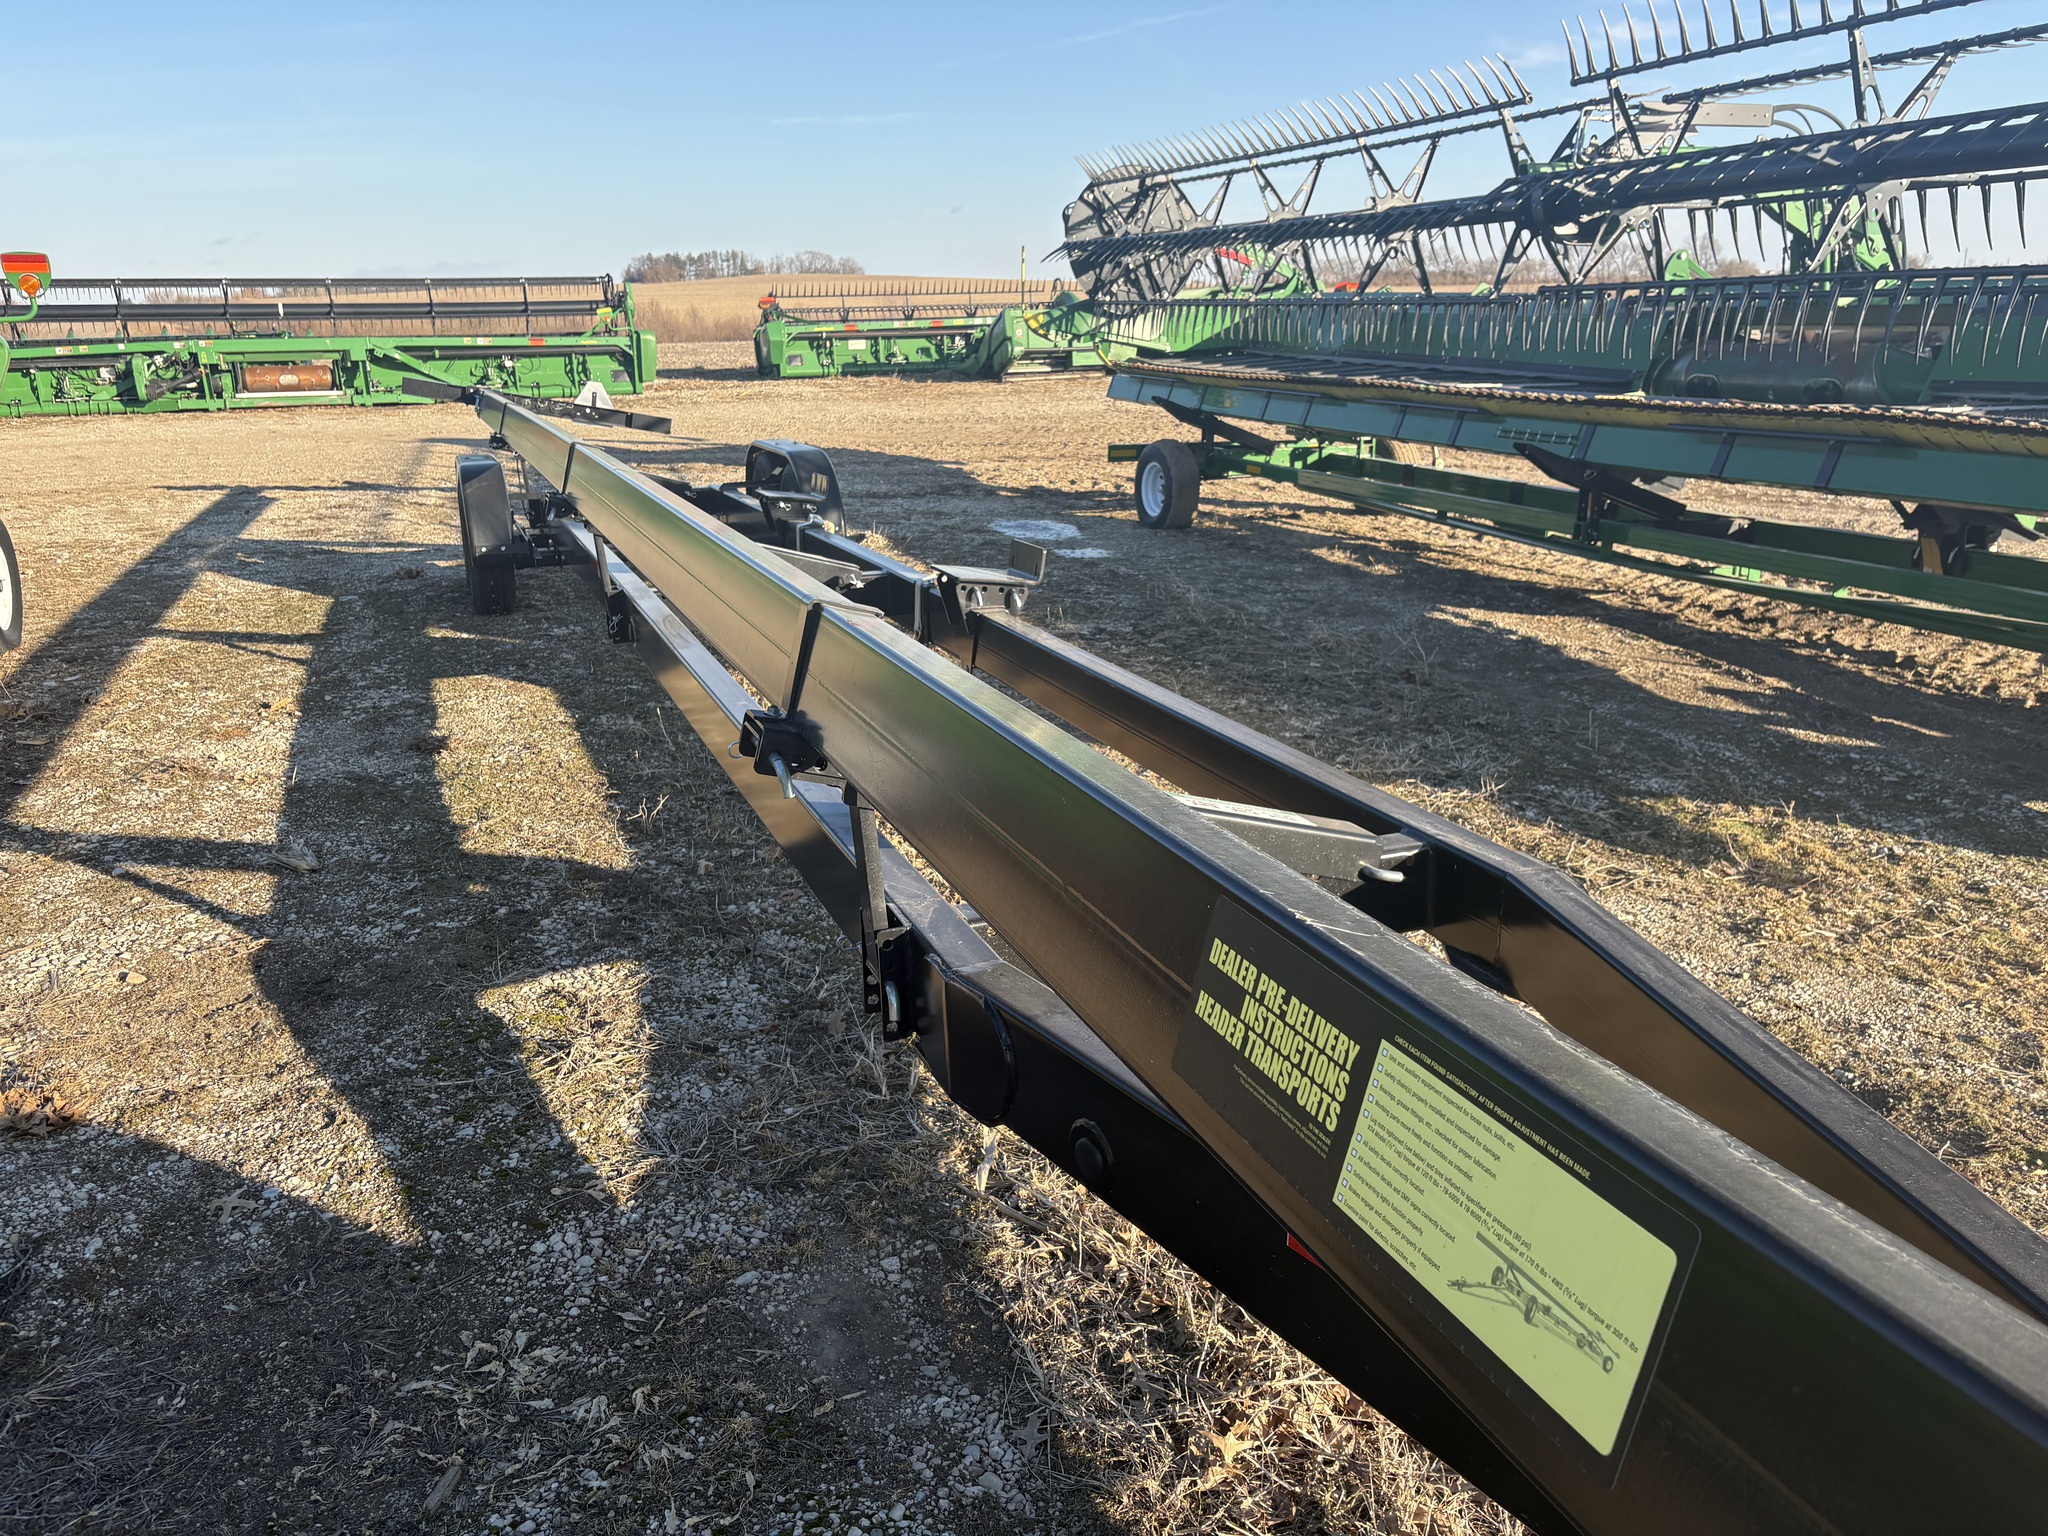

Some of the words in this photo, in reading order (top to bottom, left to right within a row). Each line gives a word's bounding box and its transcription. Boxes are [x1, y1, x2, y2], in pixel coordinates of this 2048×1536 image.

[1194, 989, 1245, 1051] HEADER
[1243, 1029, 1341, 1132] TRANSPORTS
[1208, 937, 1258, 994] DEALER
[1254, 972, 1361, 1071] PRE-DELIVERY
[1239, 993, 1350, 1102] INSTRUCTIONS
[1394, 1034, 1409, 1049] CHECK
[1407, 1044, 1421, 1057] EACH
[1419, 1052, 1432, 1065] ITEM
[1430, 1060, 1446, 1076] FOUND
[1445, 1071, 1479, 1099] SATISFACTORY
[1477, 1094, 1494, 1110] AFTER
[1493, 1105, 1514, 1124] PROPER
[1512, 1119, 1548, 1148] ADJUSTMENT
[1558, 1151, 1574, 1167] BEEN
[1573, 1162, 1591, 1181] MADE.
